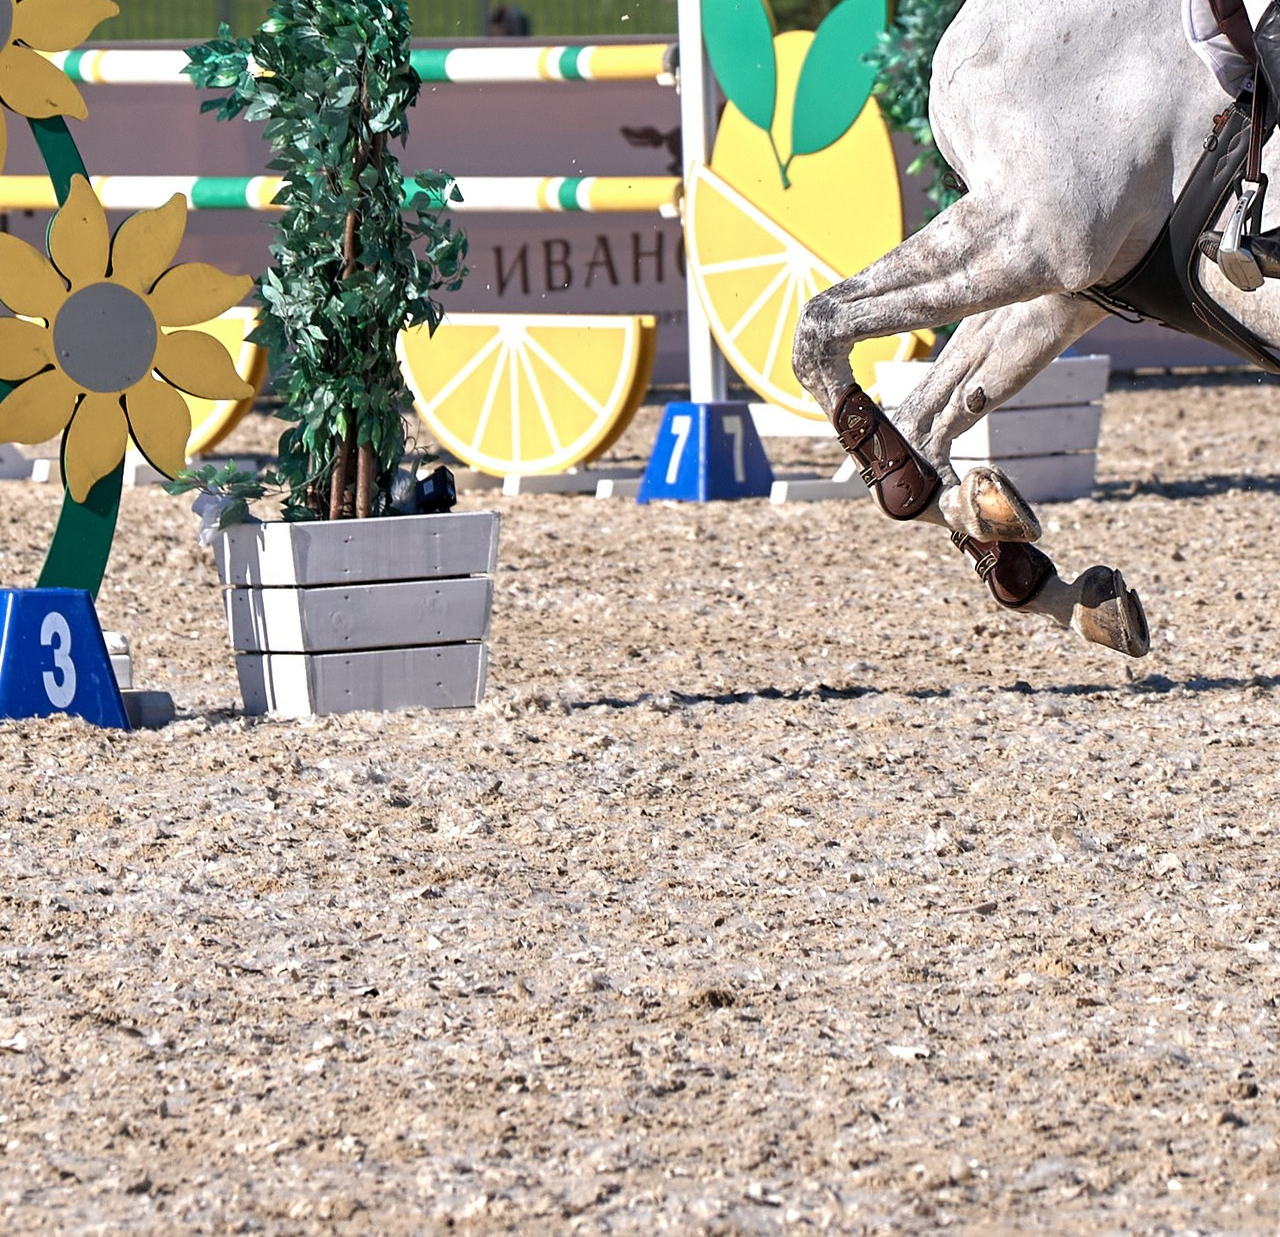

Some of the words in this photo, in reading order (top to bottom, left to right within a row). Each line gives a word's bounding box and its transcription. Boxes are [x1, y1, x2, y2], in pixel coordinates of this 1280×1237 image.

[665, 415, 692, 484] 7
[722, 415, 745, 483] 7
[40, 611, 77, 709] 3
